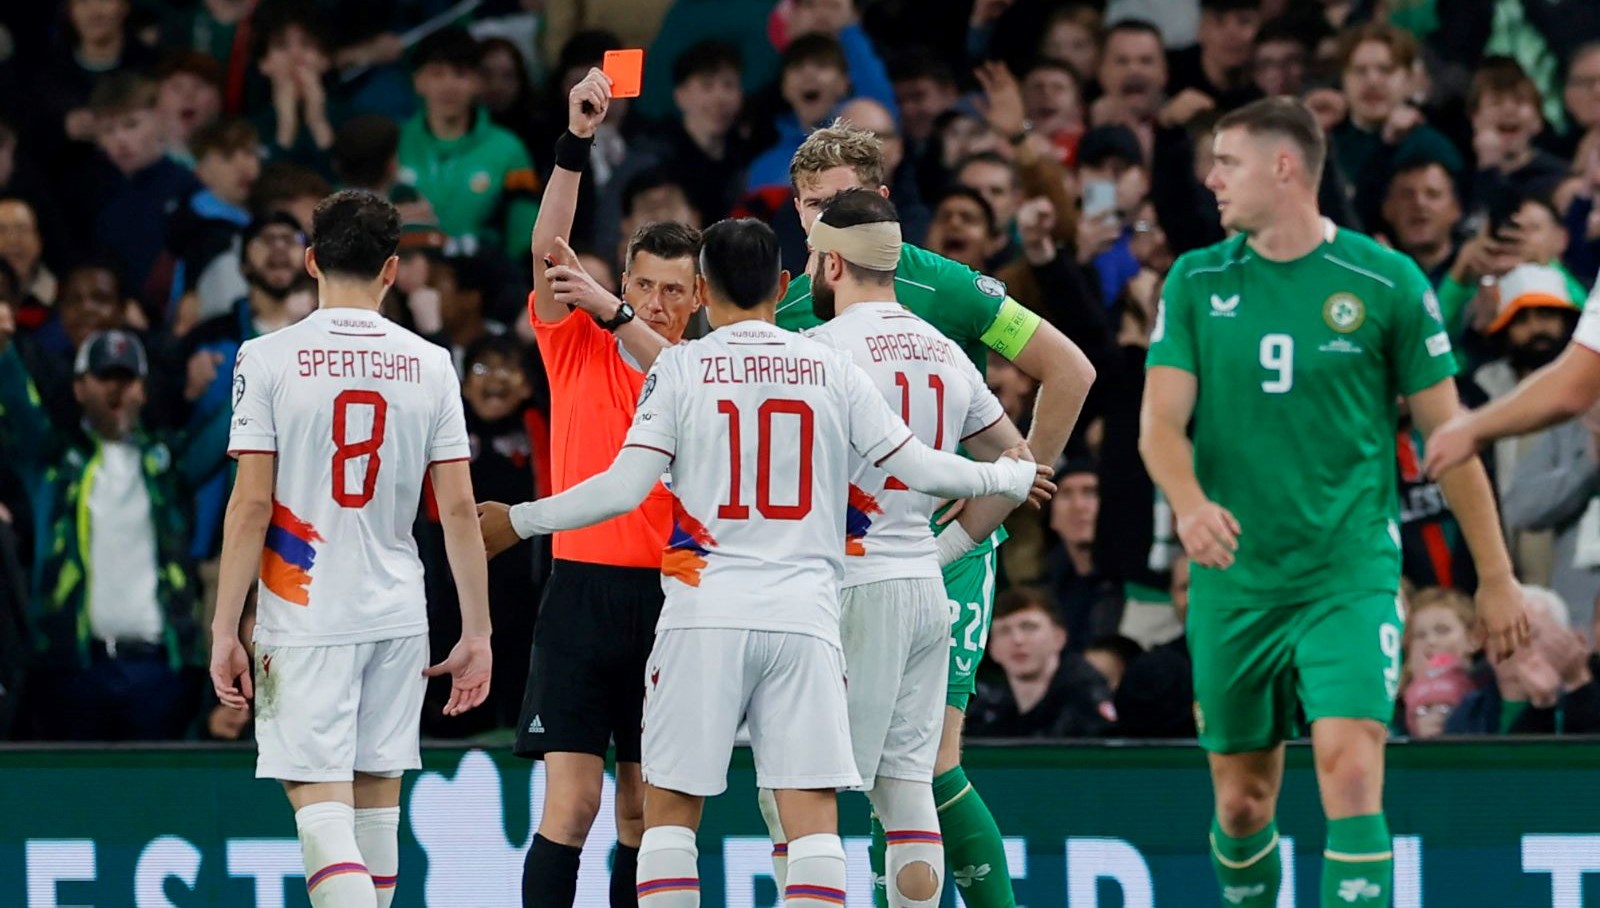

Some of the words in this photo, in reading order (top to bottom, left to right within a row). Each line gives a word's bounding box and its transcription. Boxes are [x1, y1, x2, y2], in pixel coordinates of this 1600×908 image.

[297, 349, 421, 383] SPERTSYAN
[700, 355, 826, 387] ZELARAYAN
[1259, 333, 1294, 393] 9
[331, 389, 388, 508] 8
[716, 398, 814, 520] 10
[884, 371, 945, 490] 11
[948, 599, 981, 652] 22
[1379, 622, 1399, 685] 9
